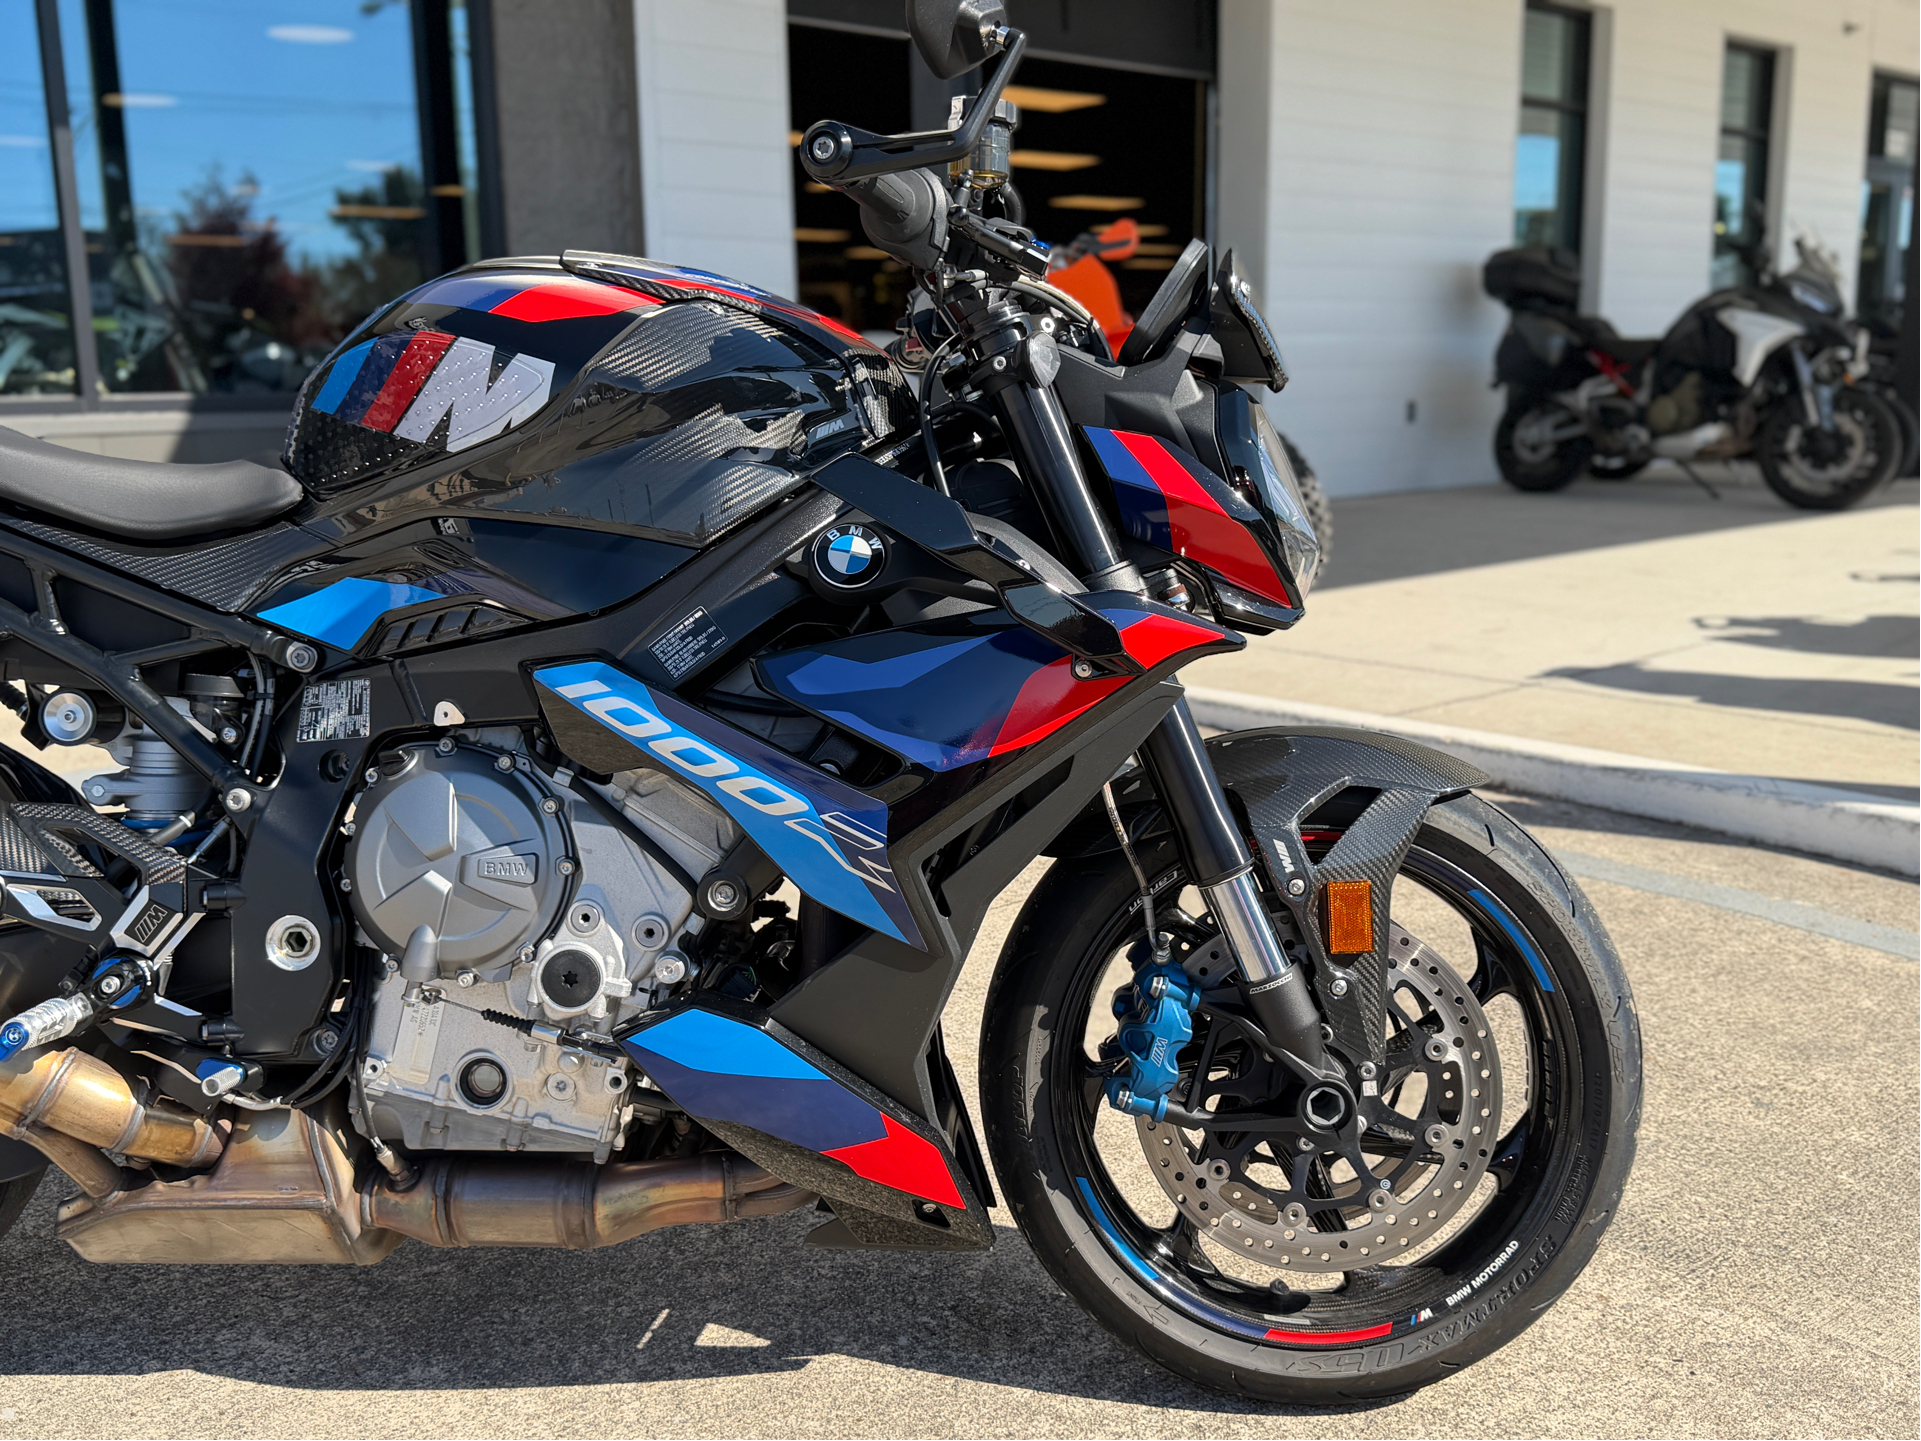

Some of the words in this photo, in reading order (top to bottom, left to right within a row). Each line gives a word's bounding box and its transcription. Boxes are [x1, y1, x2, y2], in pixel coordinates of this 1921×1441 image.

[827, 526, 883, 550] BMW
[484, 862, 529, 876] BMW
[1417, 1235, 1557, 1353] SPORTMAX
[1445, 1284, 1472, 1307] BMW
[1470, 1240, 1519, 1289] MOTORRAD
